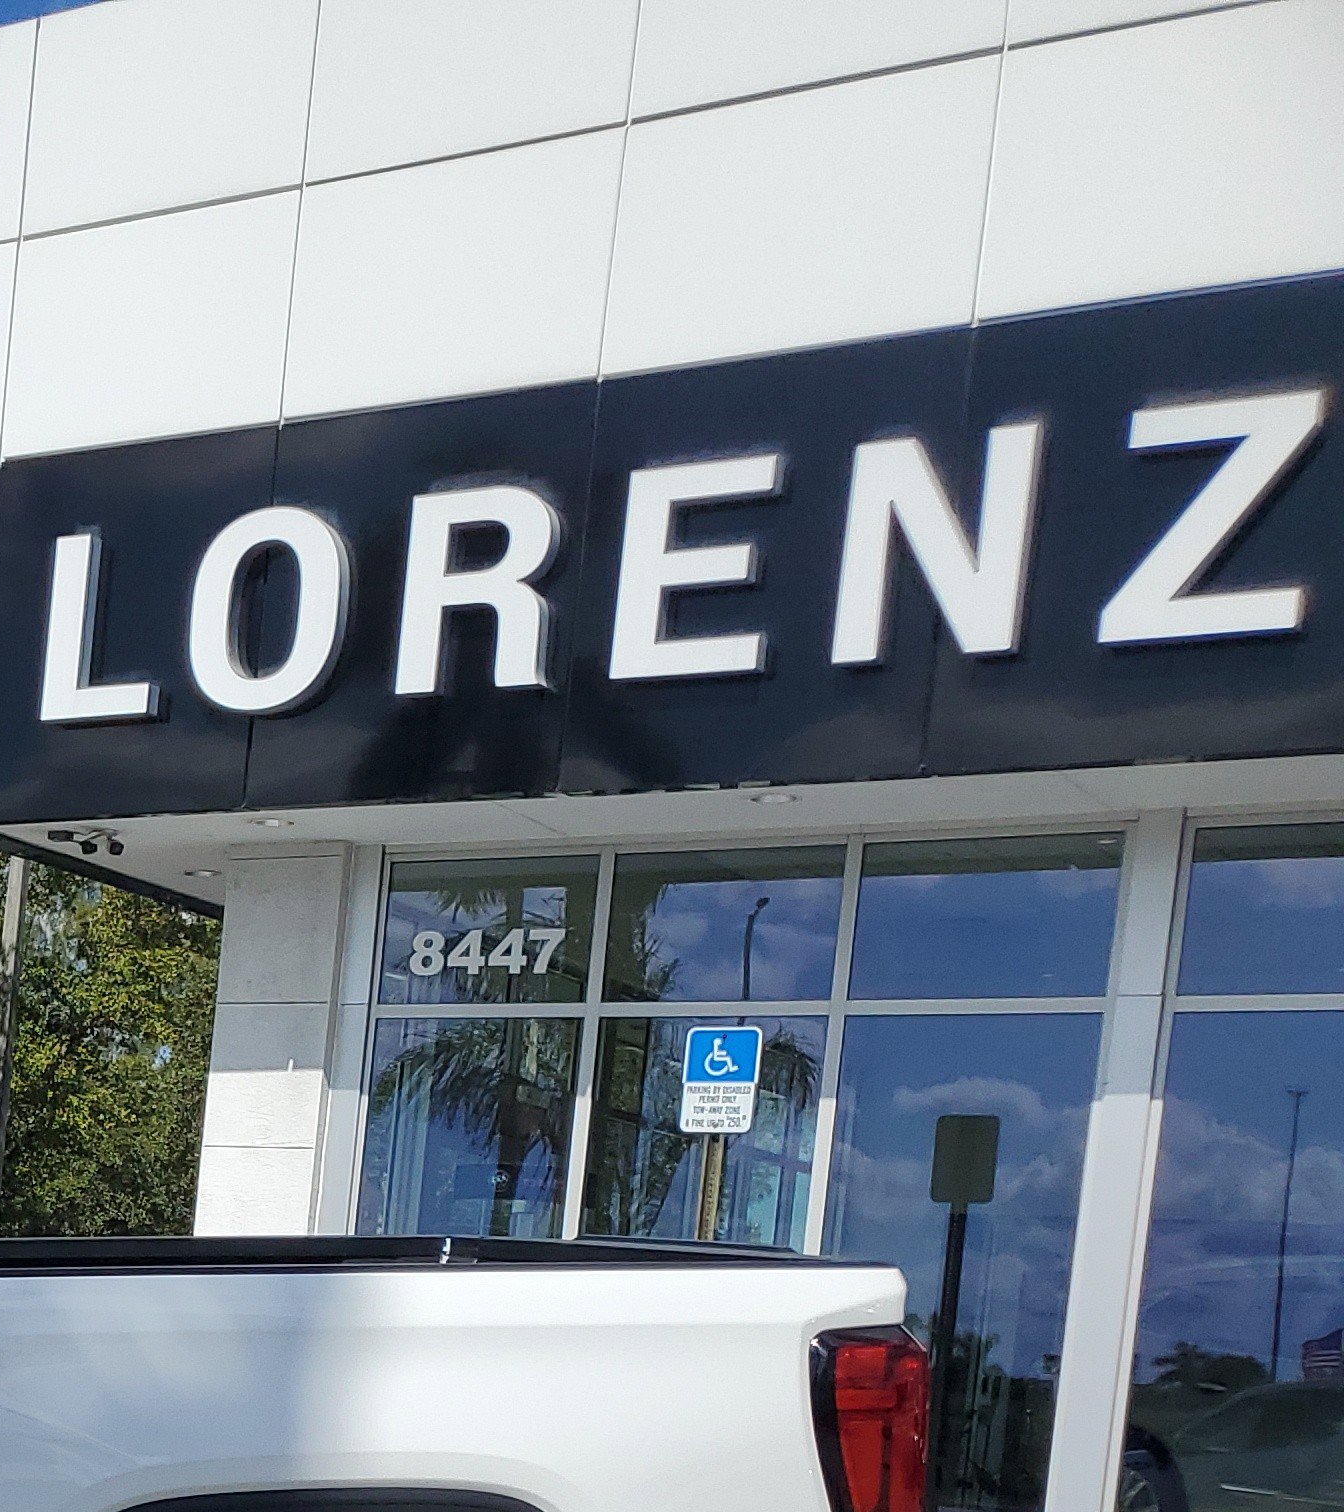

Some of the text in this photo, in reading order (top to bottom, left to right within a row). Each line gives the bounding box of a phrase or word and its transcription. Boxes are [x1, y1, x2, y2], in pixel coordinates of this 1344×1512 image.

[40, 389, 1325, 724] LORENZ
[409, 928, 566, 976] 8447
[723, 1086, 751, 1094] DISABLED
